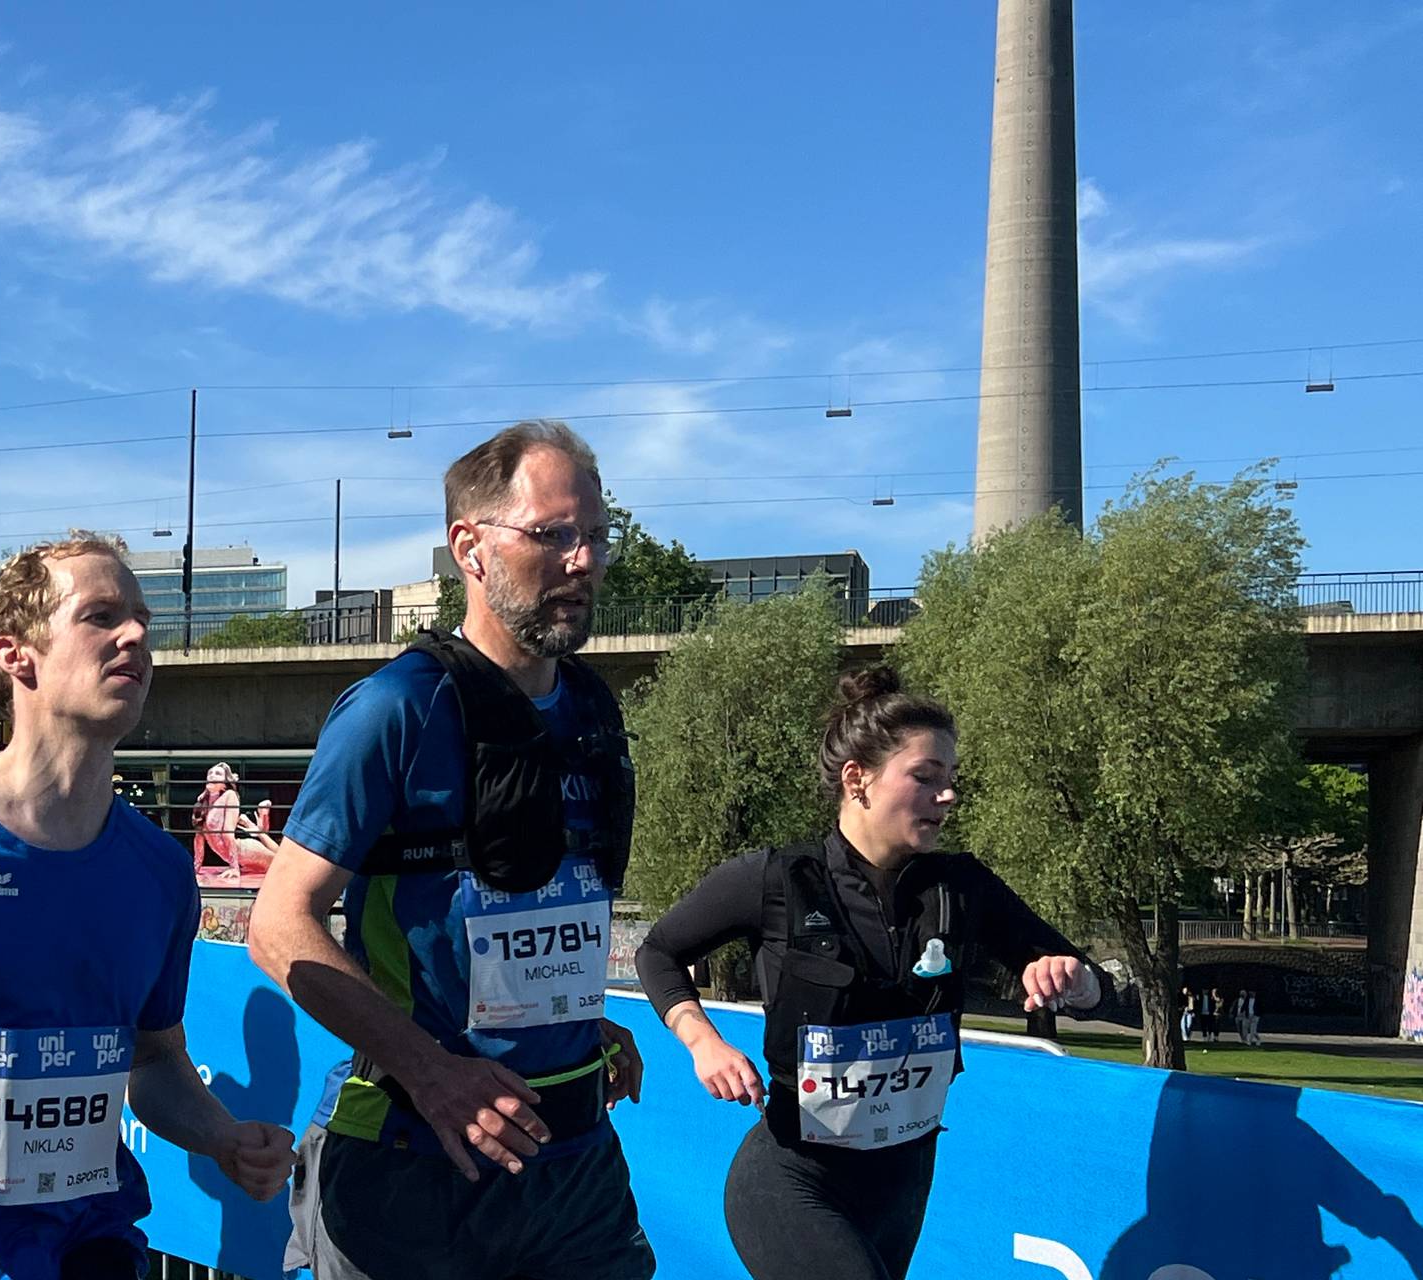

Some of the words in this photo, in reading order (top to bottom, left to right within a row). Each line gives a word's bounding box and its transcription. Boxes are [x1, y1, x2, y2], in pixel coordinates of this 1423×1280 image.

[492, 921, 601, 961] 13784
[525, 961, 585, 981] MICHAEL
[38, 1030, 65, 1052] uni
[93, 1028, 119, 1049] uni
[807, 1028, 834, 1044] uni
[861, 1023, 888, 1041] uni
[912, 1016, 937, 1036] uni
[812, 1043, 844, 1059] per
[866, 1038, 898, 1056] per
[917, 1030, 947, 1050] per
[41, 1050, 76, 1072] per
[97, 1047, 125, 1070] per
[821, 1066, 933, 1100] 14737
[869, 1102, 891, 1115] INA
[23, 1137, 75, 1155] NIKLAS
